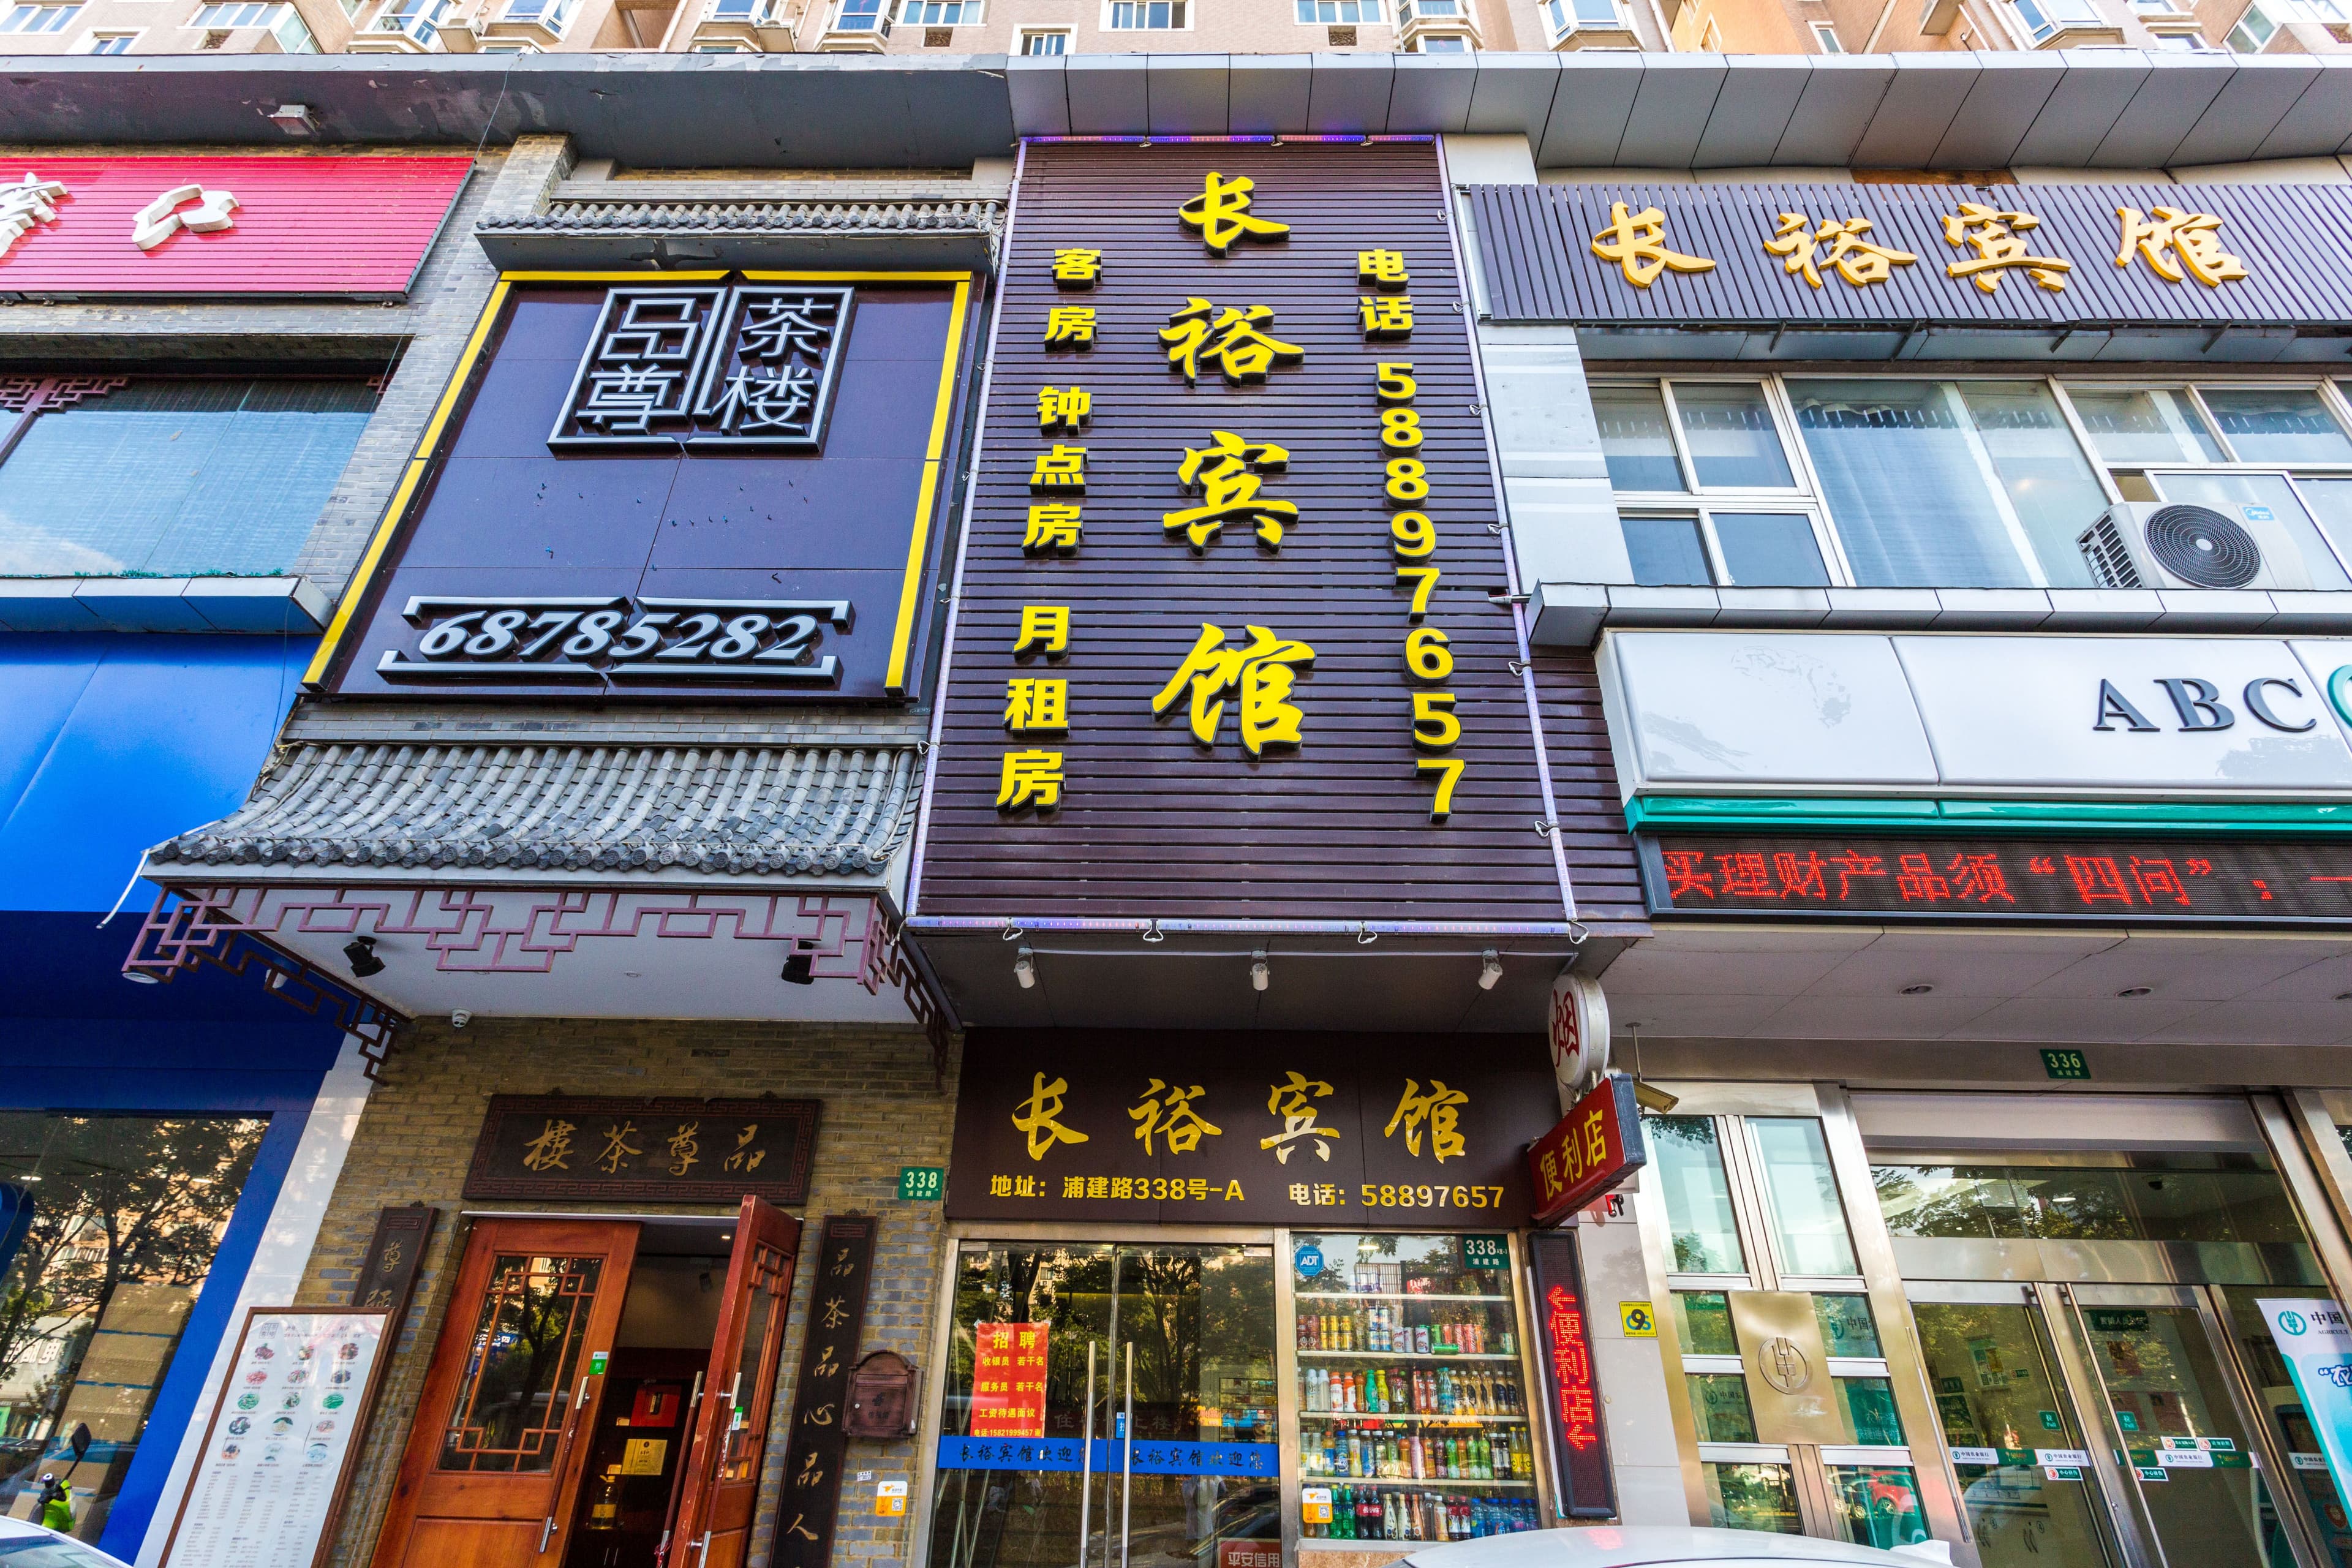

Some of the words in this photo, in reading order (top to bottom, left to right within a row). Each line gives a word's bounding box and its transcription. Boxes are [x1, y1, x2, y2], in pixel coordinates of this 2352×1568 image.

[1591, 202, 2249, 294] 长裕宾馆
[1044, 248, 1102, 350] 客房
[1359, 249, 1414, 339] 电话
[1022, 385, 1090, 554] 钟点房
[1152, 170, 1316, 761] 长裕宾馆
[1376, 363, 1466, 822] 58897657
[417, 609, 821, 662] 68785282
[995, 605, 1071, 812] 月租房
[2092, 678, 2317, 733] ABC
[1551, 988, 1579, 1068] 烟
[2048, 1053, 2081, 1068] 336
[1011, 1071, 1470, 1165] 长裕宾馆
[905, 1171, 938, 1188] 338
[1539, 1109, 1607, 1201] 便利店
[1300, 1255, 1319, 1266] ADT
[1466, 1239, 1496, 1255] 338
[993, 1331, 1036, 1349] 招聘
[2310, 1311, 2347, 1325] 中国
[786, 1247, 855, 1540] 品茶品心品人
[981, 1381, 1008, 1392] 服务员
[1016, 1382, 1043, 1392] 若干名
[982, 1356, 1009, 1366] 收银员
[1017, 1356, 1044, 1366] 若干名
[1548, 1311, 1596, 1425] 便利店
[979, 1408, 1035, 1419] 工资待遇面议
[1227, 1551, 1280, 1568] 平安信用
